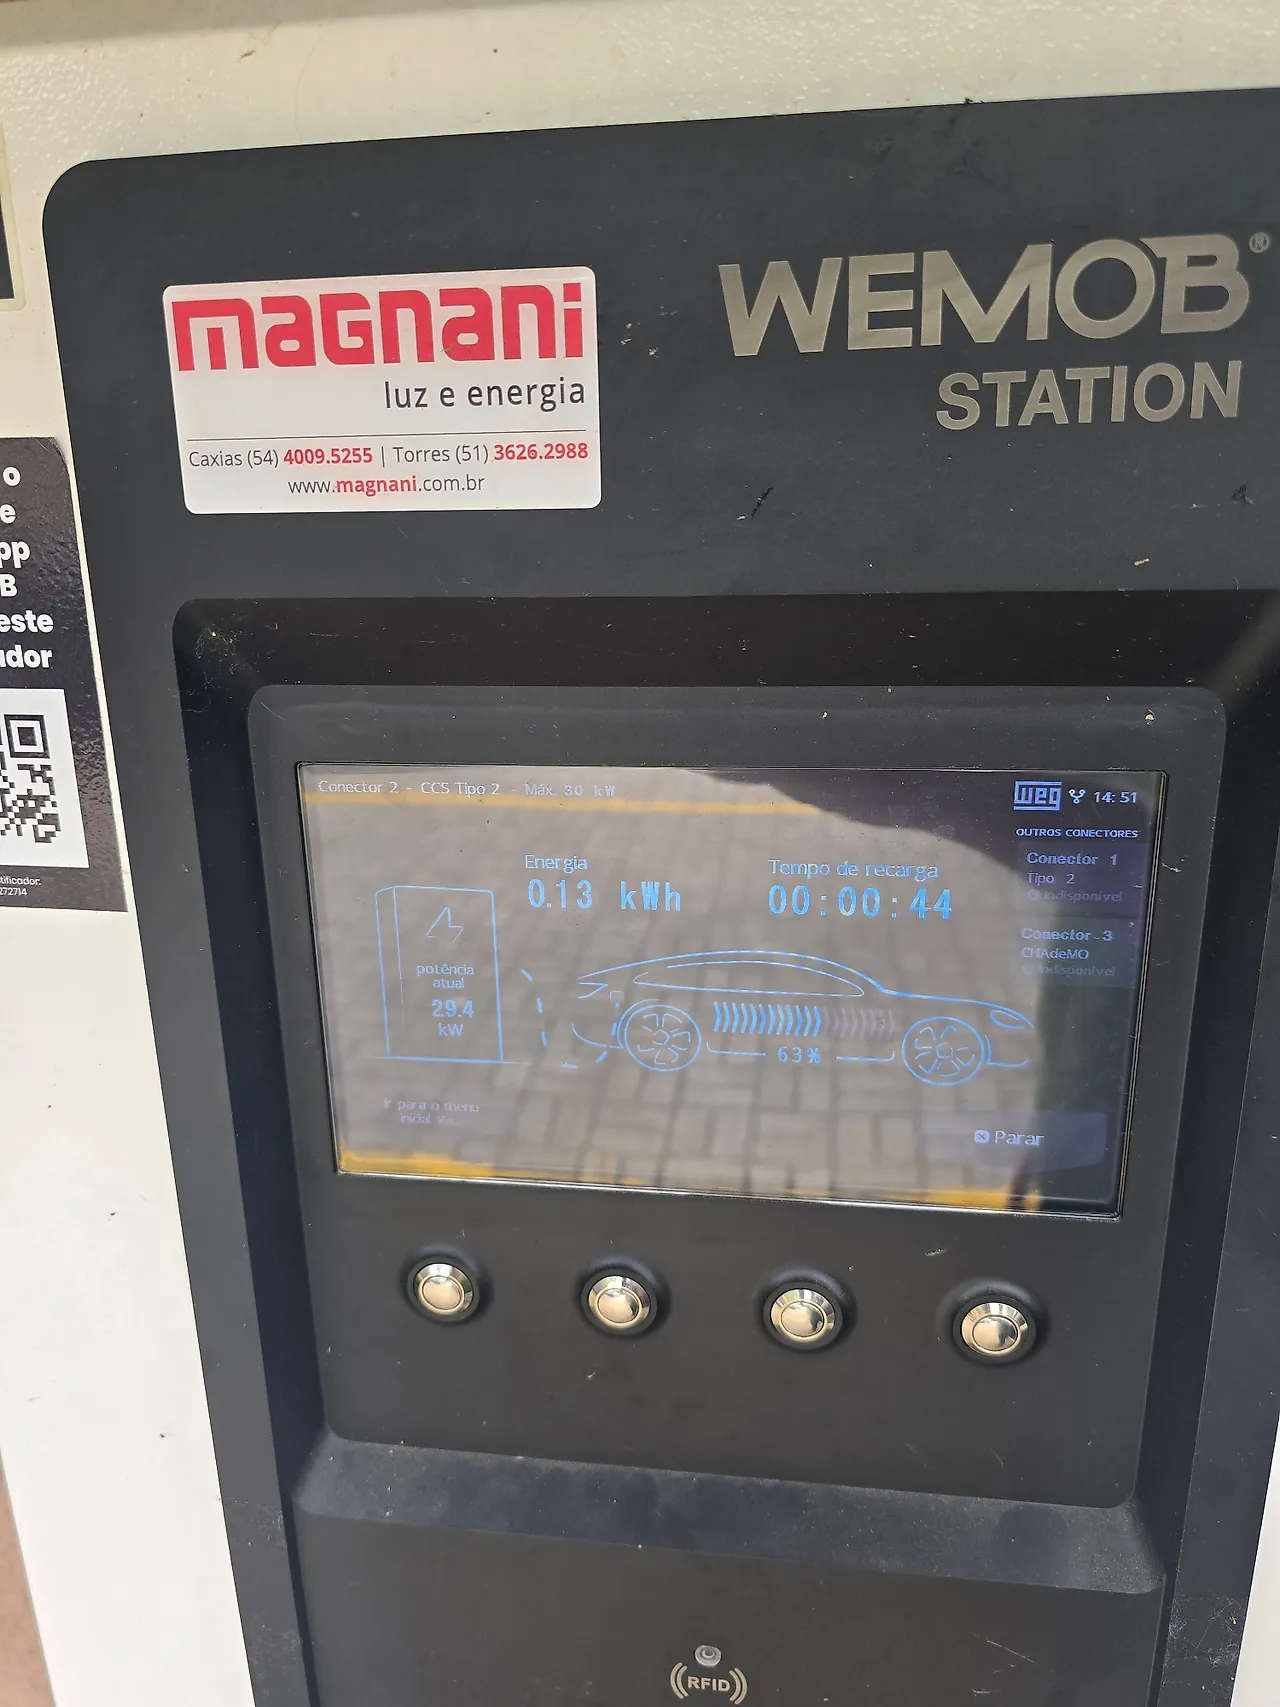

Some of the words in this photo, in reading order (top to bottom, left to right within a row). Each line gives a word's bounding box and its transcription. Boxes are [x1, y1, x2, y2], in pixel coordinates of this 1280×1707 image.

[384, 381, 428, 409] luz
[439, 387, 456, 406] e
[467, 377, 586, 412] energia
[936, 360, 1242, 430] STATION
[188, 450, 243, 468] Caxias
[246, 450, 280, 469] (54)
[283, 447, 373, 466] 4009.5255
[393, 446, 450, 464] Torres
[455, 443, 489, 463] (51)
[493, 442, 589, 462] 3626.2988
[287, 474, 485, 498] www.magnani.com.br
[318, 780, 382, 793] Conector
[389, 781, 398, 794] 2
[420, 782, 449, 795] CCS
[455, 783, 485, 799] Tipo
[491, 784, 500, 796] 2
[524, 783, 557, 796] Máx.
[1016, 828, 1062, 837] OUTROS
[1065, 828, 1139, 838] CONECTORES
[525, 854, 588, 874] Energia
[1027, 852, 1098, 865] Conector
[1110, 854, 1118, 866] 1
[767, 859, 830, 879] Tempo
[836, 861, 859, 876] de
[865, 863, 939, 882] recarga
[1027, 872, 1055, 886] Tipo
[1066, 874, 1075, 885] 2
[528, 878, 593, 909] 0.13
[620, 880, 681, 911] kWh
[768, 884, 952, 919] 00:00:44
[1021, 927, 1092, 941] Conector
[1102, 929, 1113, 942] 3
[1021, 947, 1089, 960] CHAdeMO
[416, 964, 475, 976] potência
[433, 978, 465, 989] atual
[432, 999, 475, 1018] 29.4
[438, 1023, 464, 1037] kW
[777, 1046, 822, 1064] 63%
[398, 1101, 427, 1111] para
[995, 1130, 1045, 1147] Parar
[687, 1676, 731, 1692] RFID
